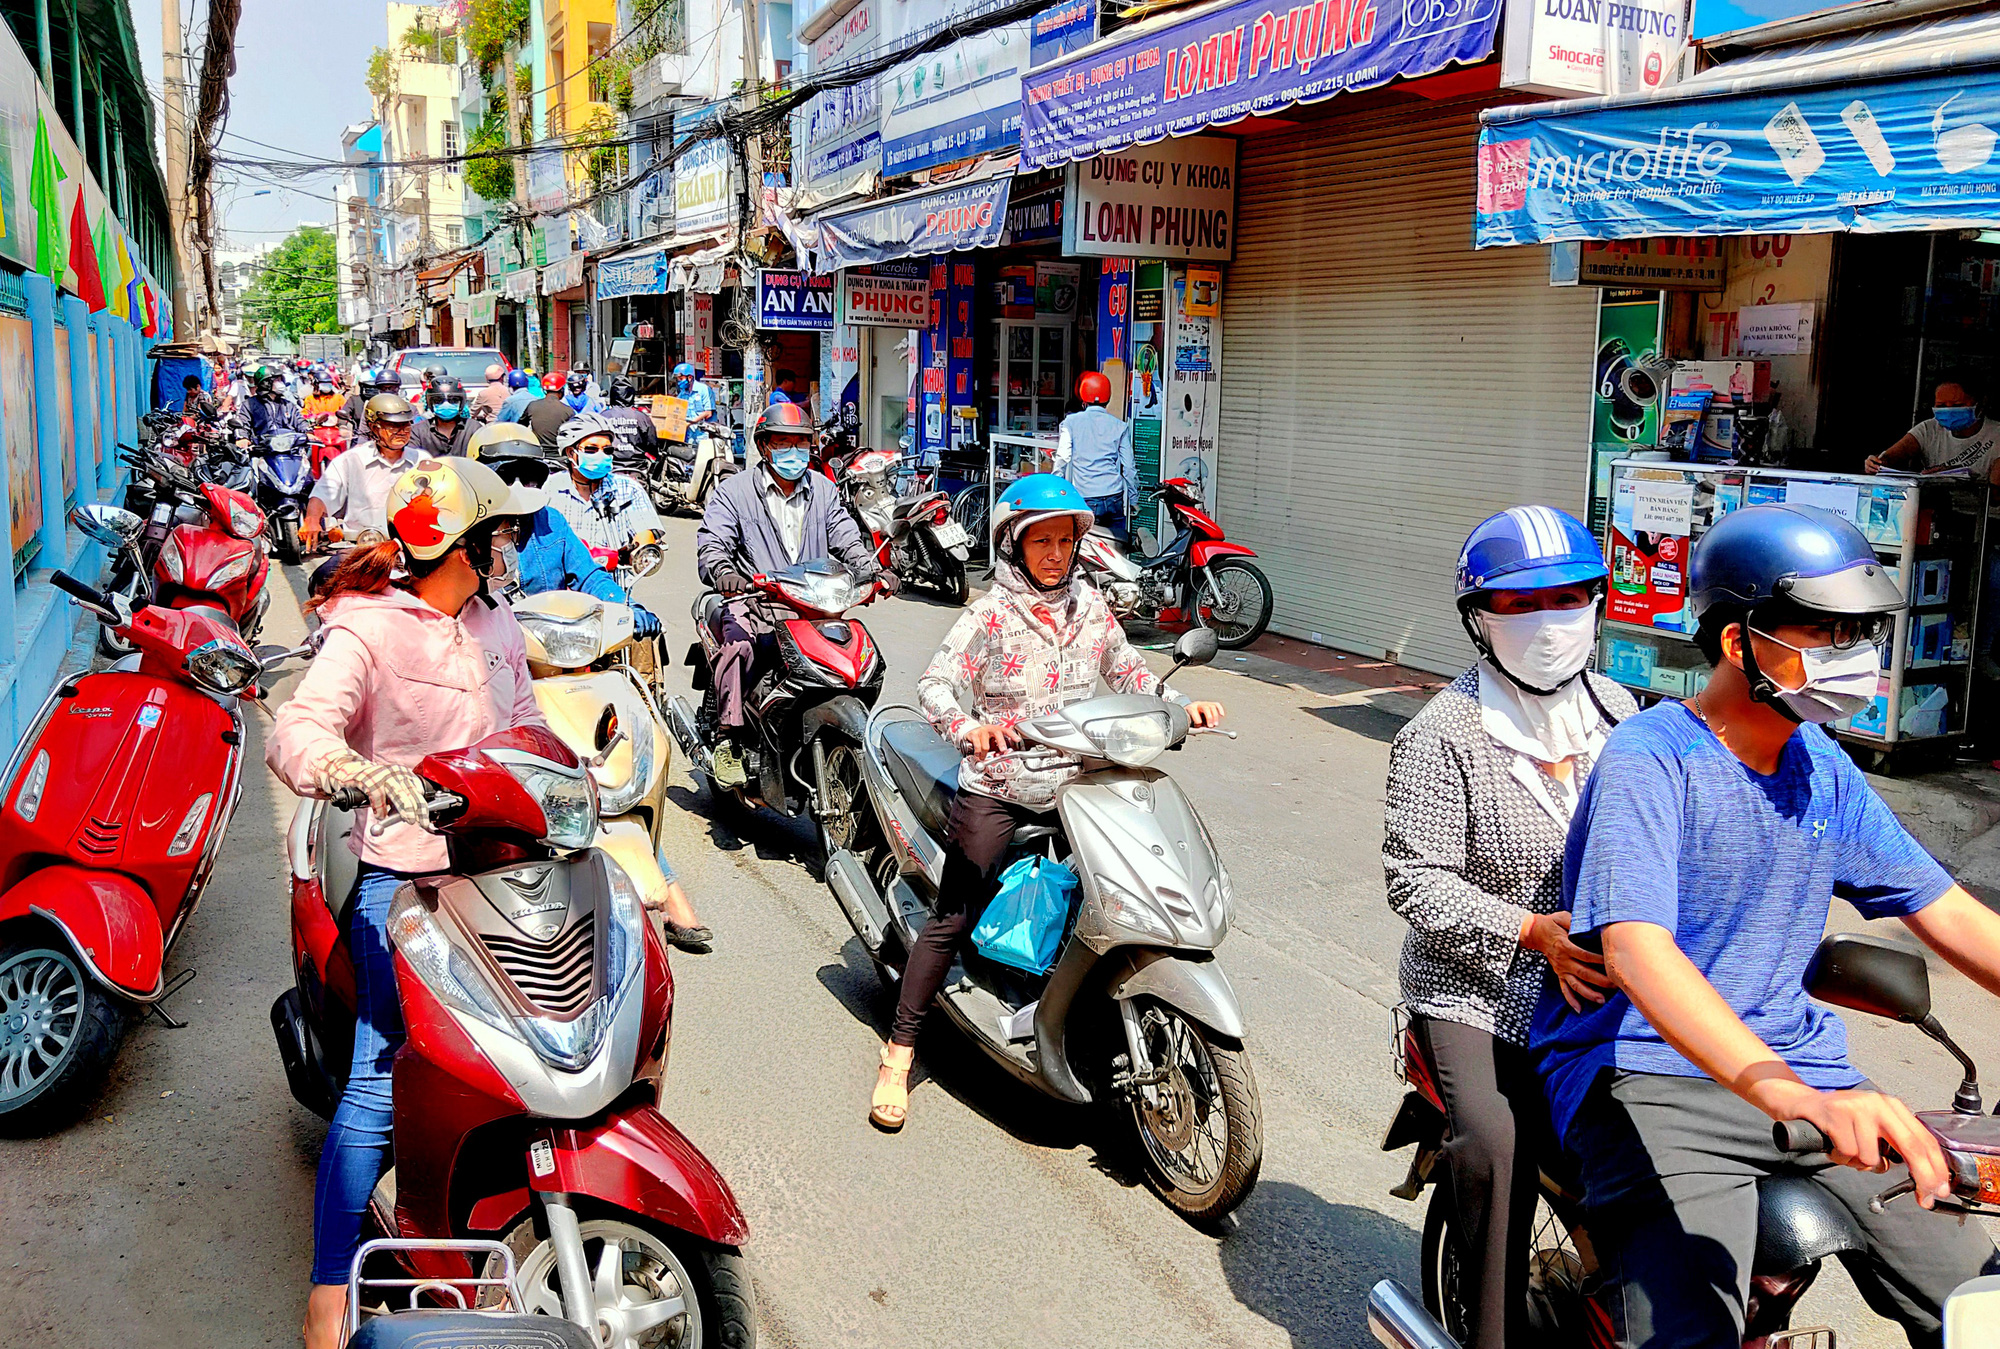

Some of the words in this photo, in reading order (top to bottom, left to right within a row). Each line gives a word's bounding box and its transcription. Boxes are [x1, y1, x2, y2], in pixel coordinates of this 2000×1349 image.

[1607, 3, 1677, 39] PHỤNG
[1164, 24, 1245, 103] LOAN
[1248, 0, 1378, 79] PHỤNG
[1549, 45, 1605, 68] Sinocare
[1090, 62, 1113, 89] DỤNG
[1114, 57, 1126, 82] CỤ
[1127, 53, 1135, 75] Y
[1136, 46, 1160, 71] KHOA
[1281, 77, 1343, 102] 0906.927.215
[1345, 65, 1379, 87] (LOAN)
[1483, 158, 1525, 175] Swiss
[1531, 122, 1732, 189] microlife
[1091, 157, 1138, 185] DỤNG
[1142, 160, 1164, 189] CỤ
[1170, 162, 1182, 186] Y
[1187, 164, 1231, 190] KHOA
[1483, 177, 1524, 196] Brand
[921, 195, 946, 211] DỤNG
[947, 191, 962, 207] CỤ
[963, 191, 970, 201] Y
[971, 184, 1000, 199] KHOA
[1678, 181, 1698, 196] For
[1700, 180, 1725, 194] life.
[925, 200, 993, 240] PHỤNG
[1030, 203, 1050, 229] KHOA
[1083, 201, 1143, 244] LOAN
[1150, 205, 1228, 255] PHỤNG
[765, 273, 789, 288] DỤNG
[790, 275, 801, 289] CỤ
[809, 277, 831, 288] KHOA
[873, 262, 918, 274] microlife
[954, 263, 974, 289] DỤNG
[847, 277, 863, 290] DỤNG
[865, 278, 873, 291] CỤ
[873, 279, 879, 289] Y
[879, 280, 894, 290] KHOA
[764, 290, 796, 312] AN
[802, 291, 833, 313] AN
[852, 291, 923, 317] PHỤNG
[1109, 283, 1127, 323] CỤ
[923, 368, 945, 393] KHOA
[69, 702, 114, 715] Vespa
[511, 901, 567, 918] HONDA
